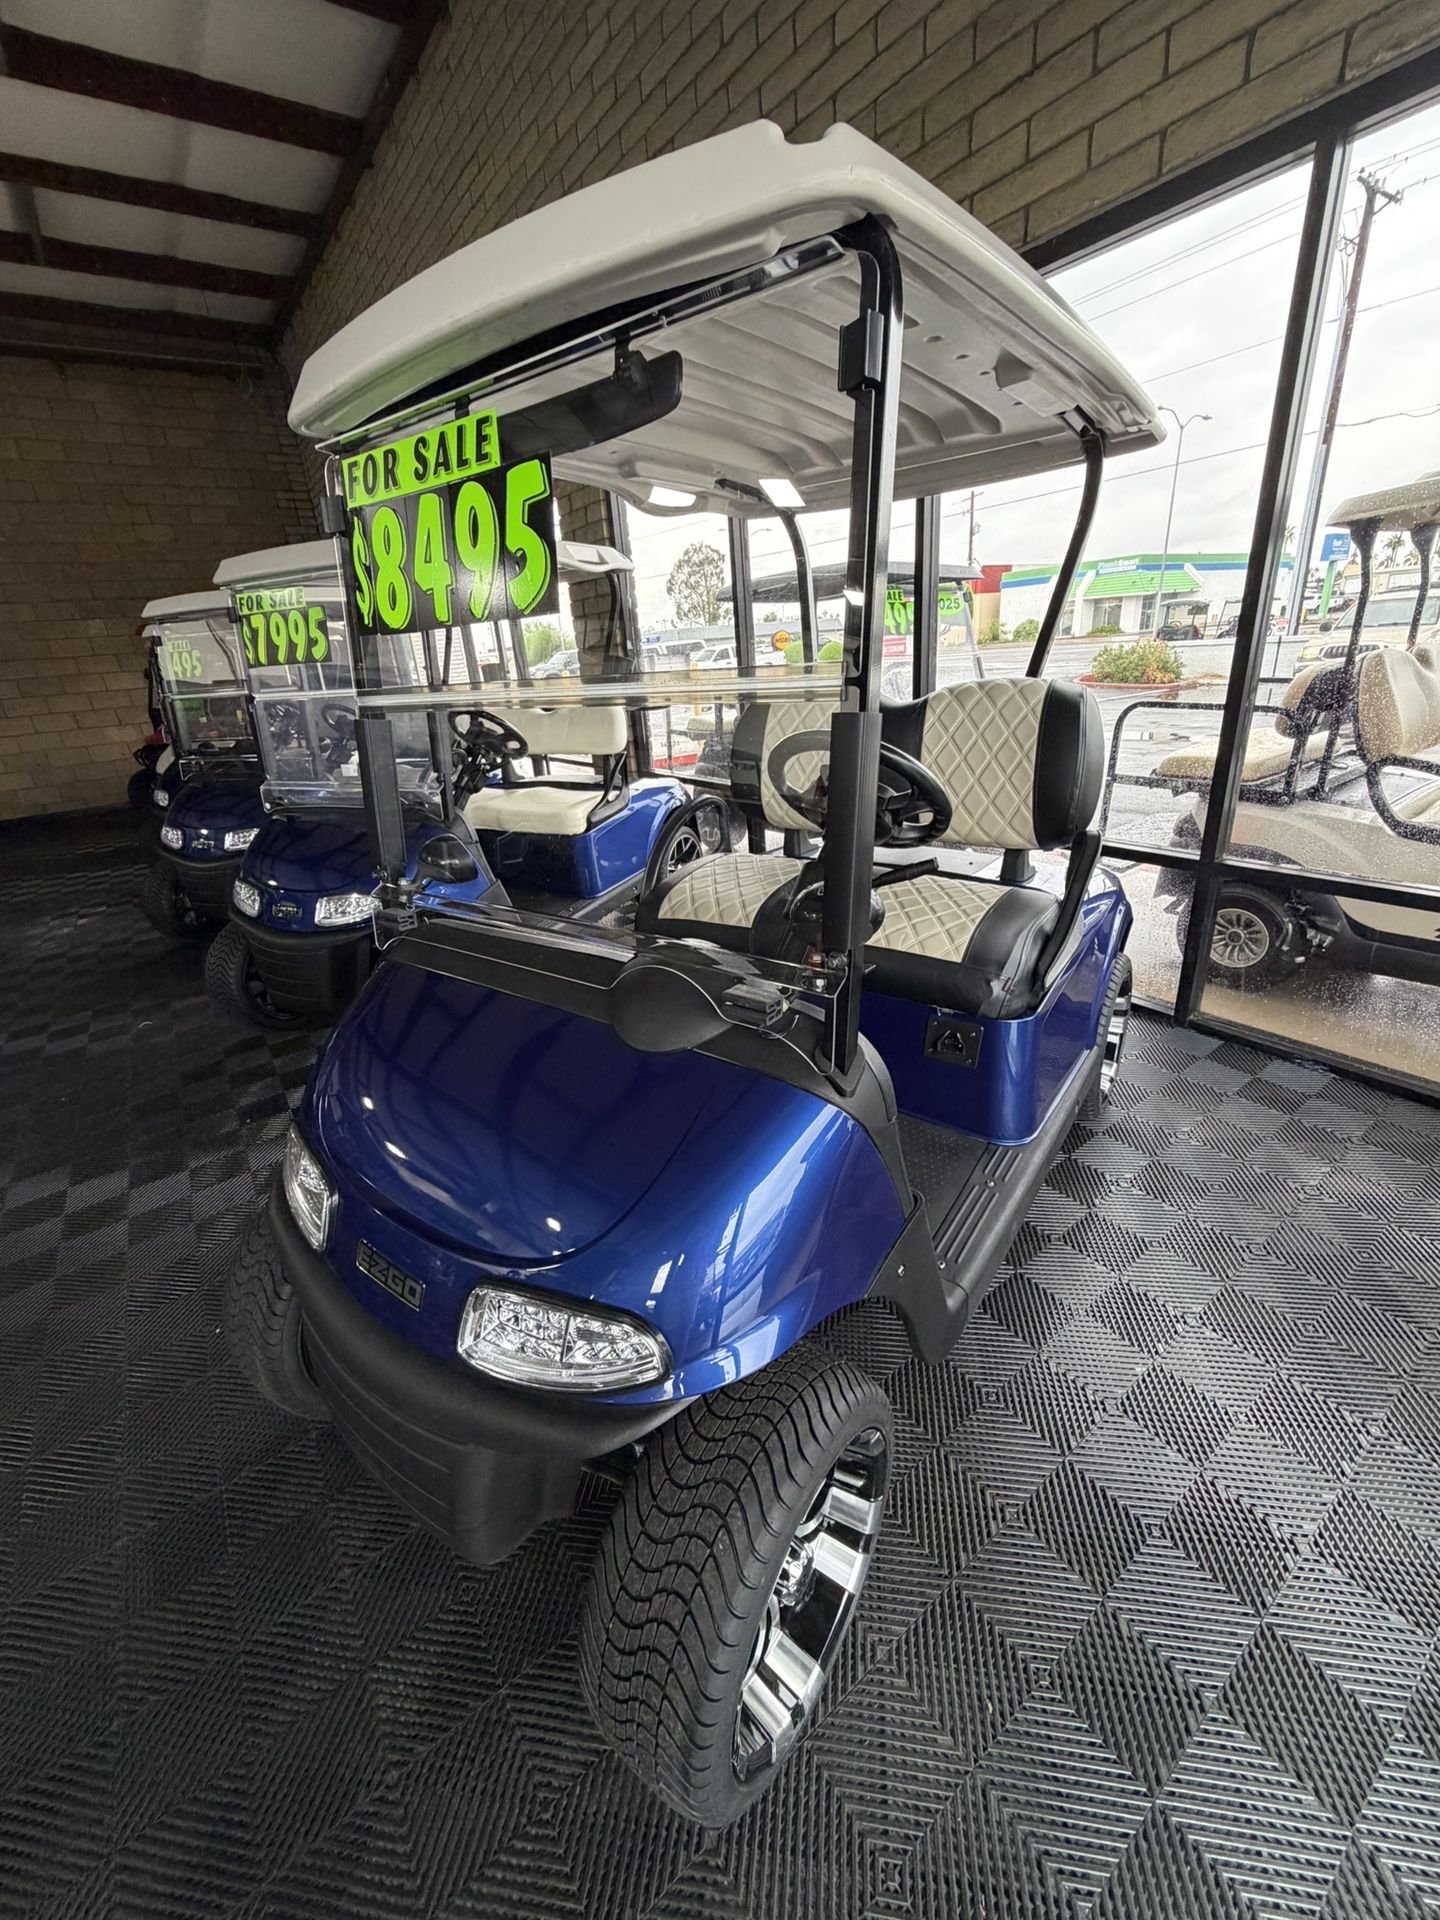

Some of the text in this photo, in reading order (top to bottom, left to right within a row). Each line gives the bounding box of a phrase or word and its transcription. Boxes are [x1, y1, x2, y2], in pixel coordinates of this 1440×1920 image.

[347, 416, 492, 499] FOR SALE
[353, 459, 550, 630] $8495
[239, 588, 304, 612] FOR SALE
[887, 591, 903, 601] ALE
[938, 598, 960, 610] 025
[243, 607, 328, 665] $7995
[359, 1242, 422, 1307] EZGO
